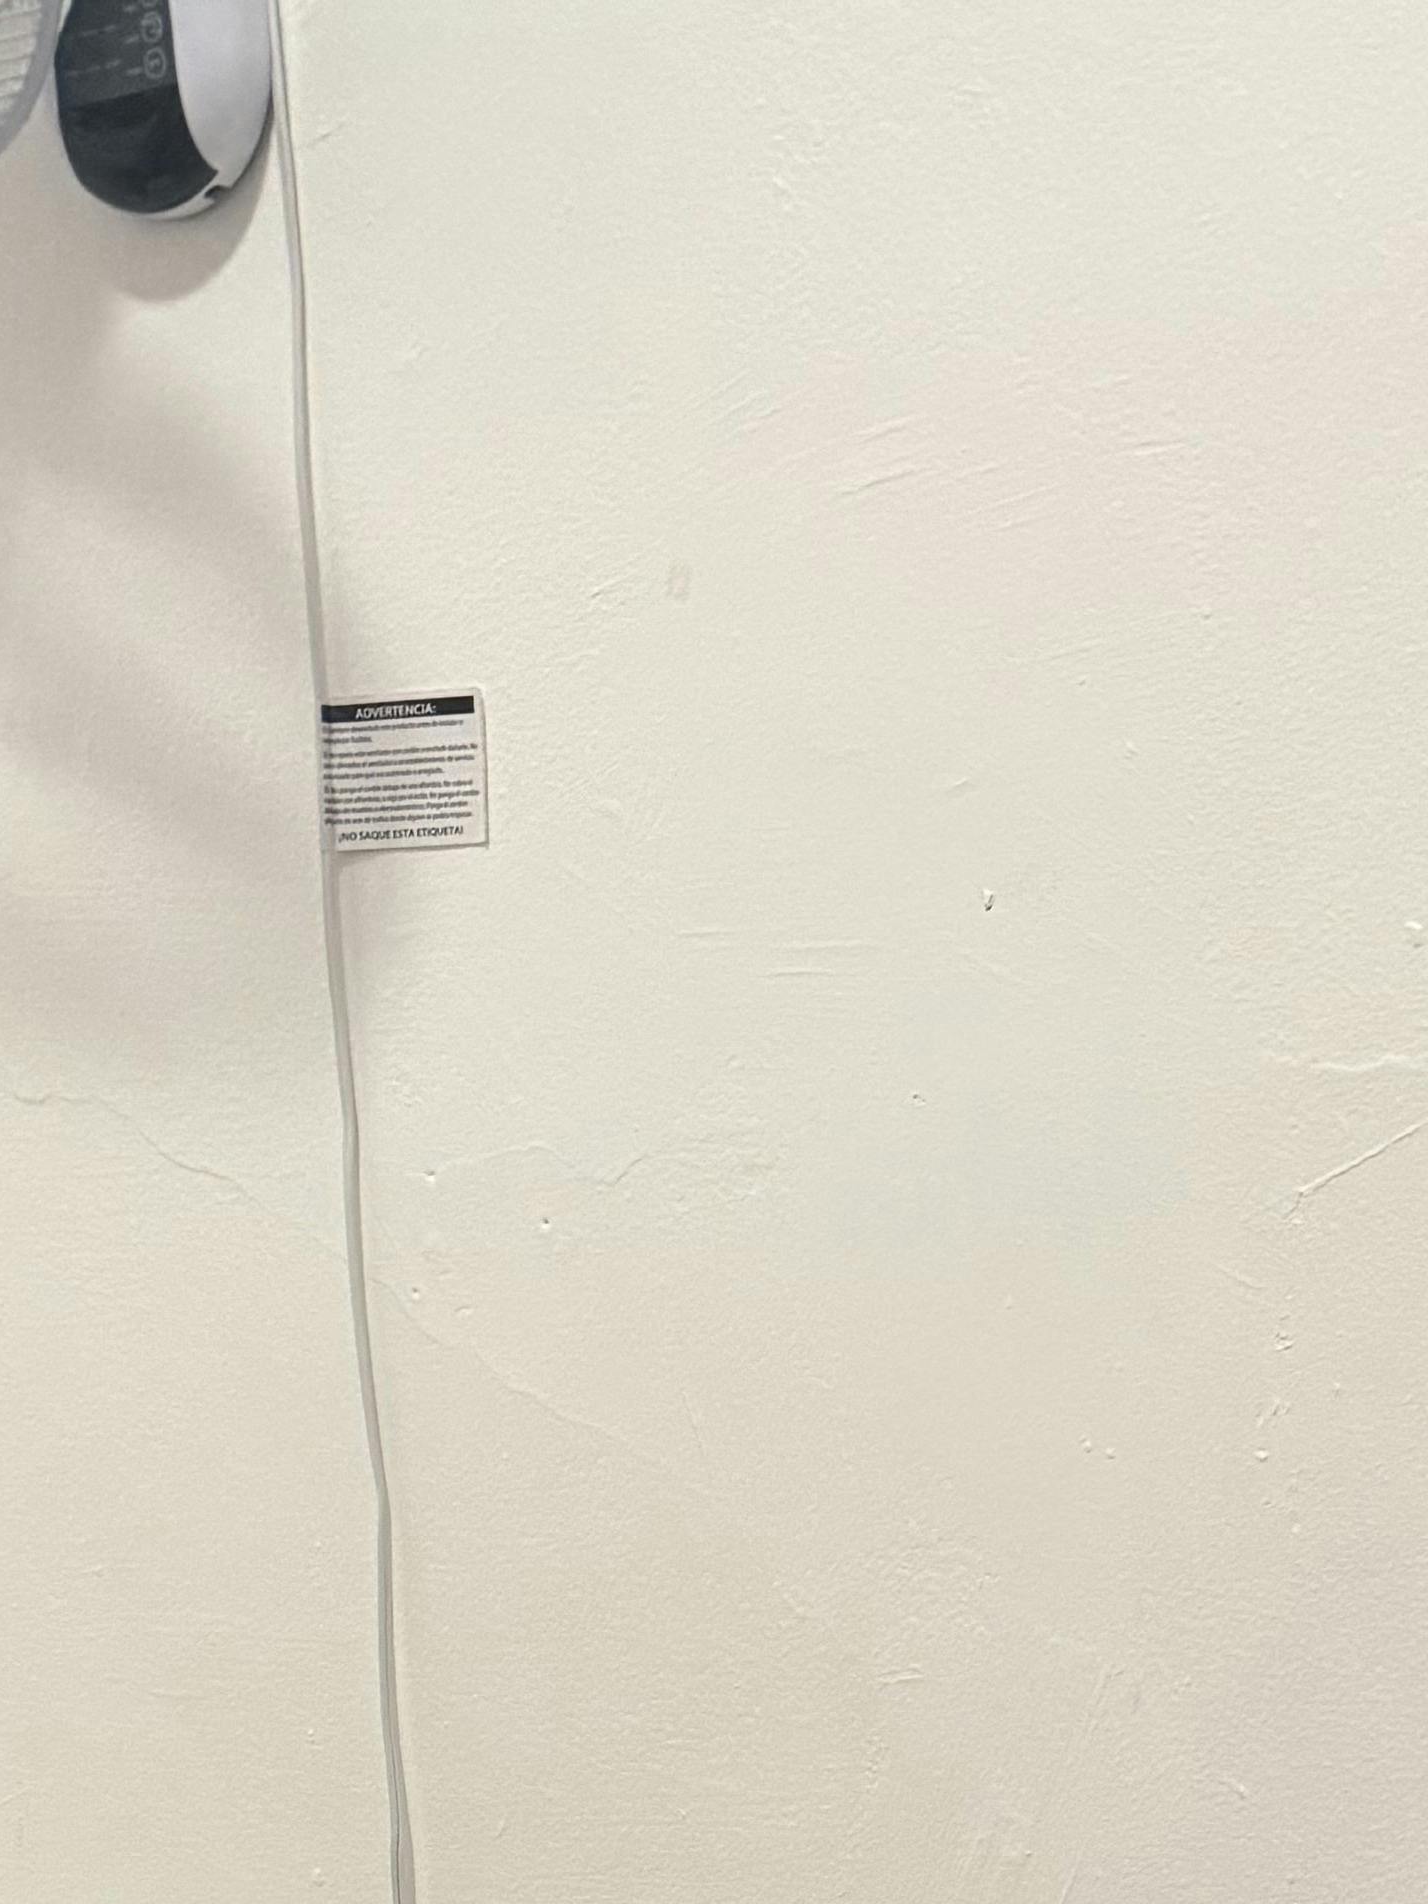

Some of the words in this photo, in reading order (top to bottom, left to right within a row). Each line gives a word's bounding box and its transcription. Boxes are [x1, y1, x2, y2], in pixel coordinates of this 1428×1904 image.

[355, 703, 436, 719] ADVERTENCIA:
[359, 829, 391, 840] SAQUE
[393, 828, 415, 839] ESTA
